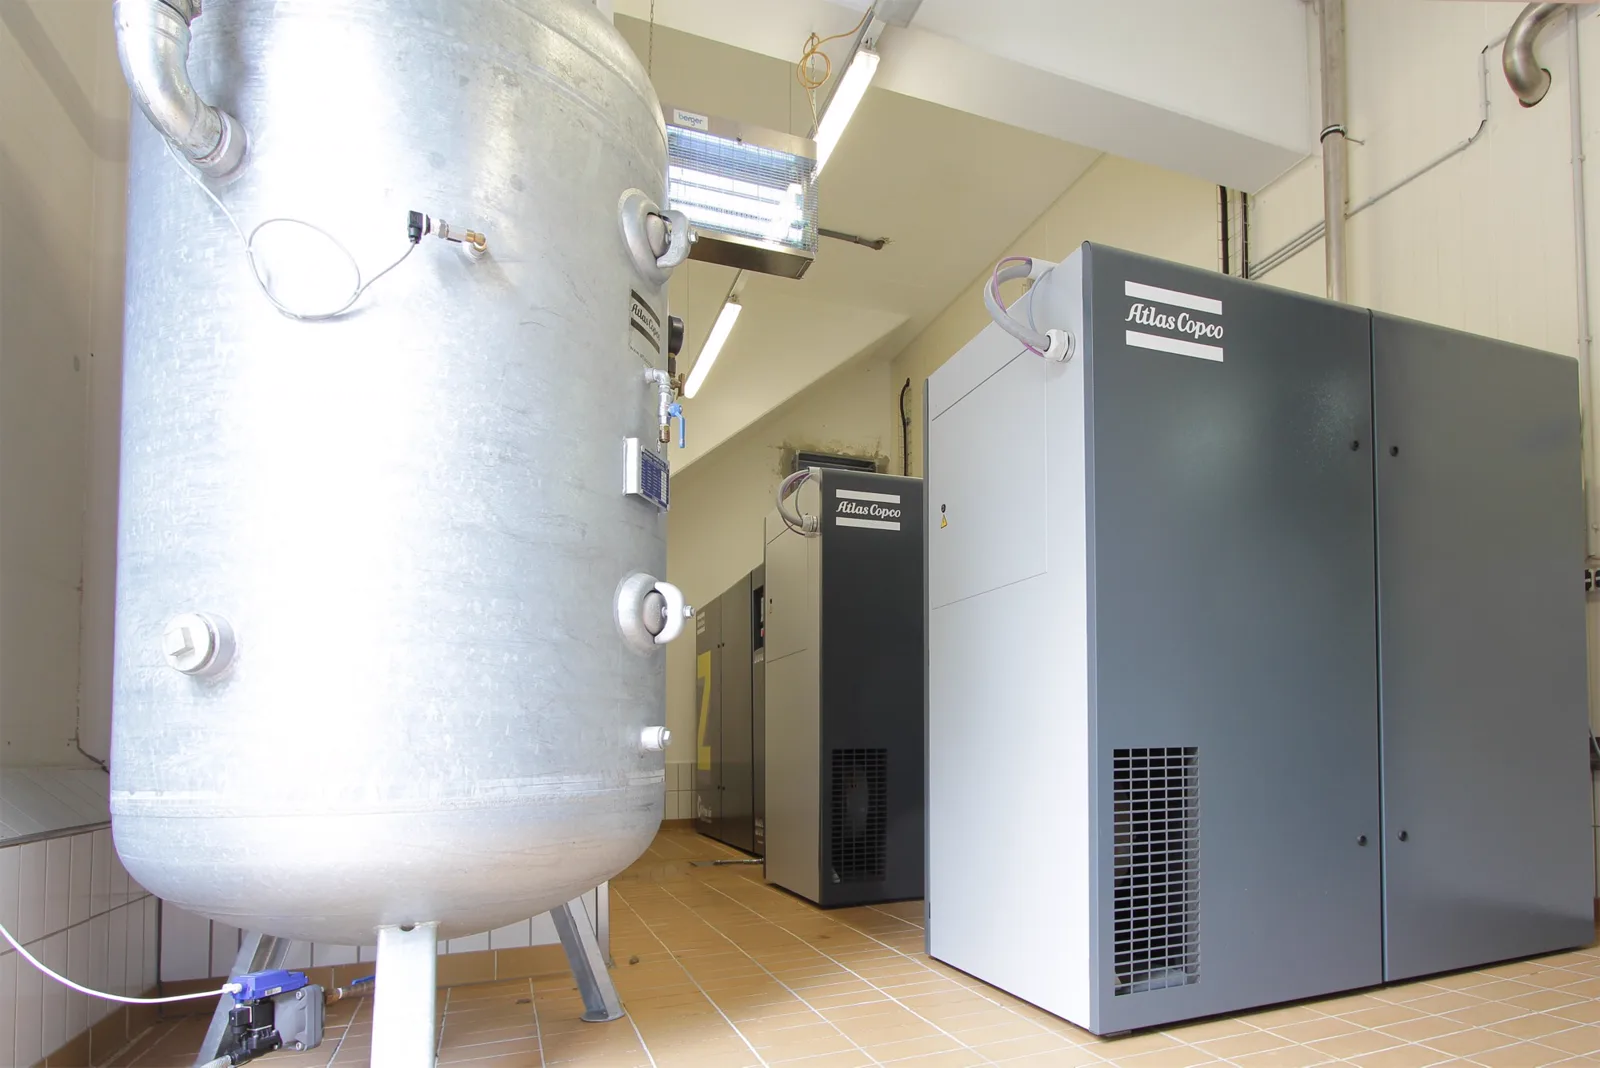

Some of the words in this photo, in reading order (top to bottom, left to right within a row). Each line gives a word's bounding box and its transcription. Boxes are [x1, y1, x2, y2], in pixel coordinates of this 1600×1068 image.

[678, 111, 703, 126] berger
[631, 303, 648, 326] Atlas
[1125, 303, 1176, 330] Atlas
[1177, 312, 1224, 339] Copco
[836, 500, 869, 515] Atlas
[869, 504, 901, 519] Copco
